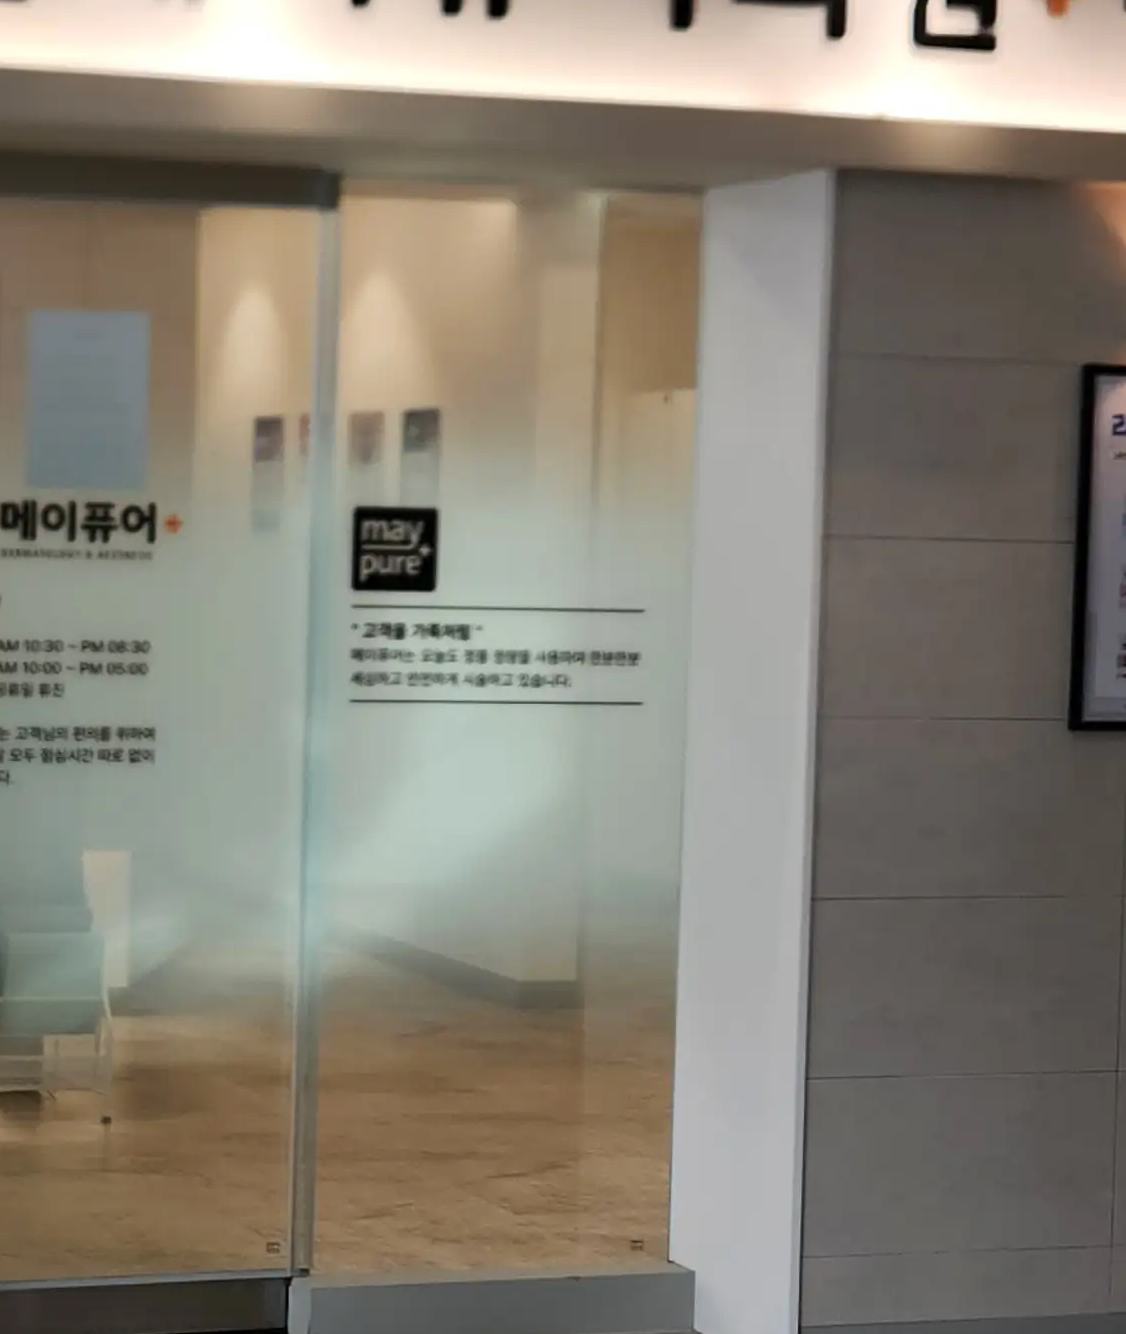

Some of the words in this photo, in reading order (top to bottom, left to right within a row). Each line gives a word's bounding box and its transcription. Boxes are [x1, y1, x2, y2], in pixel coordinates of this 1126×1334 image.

[0, 500, 158, 544] 메이퓨어
[360, 518, 424, 549] may
[359, 552, 423, 581] pure
[24, 639, 64, 653] 10:30
[80, 639, 105, 653] PM
[23, 661, 63, 675] 10:00
[79, 661, 103, 675] PM
[14, 725, 69, 742] 고객님의
[8, 748, 38, 763] 모두
[39, 748, 94, 764] 점심시간
[97, 748, 124, 763] 따로
[128, 748, 156, 765] 없이
